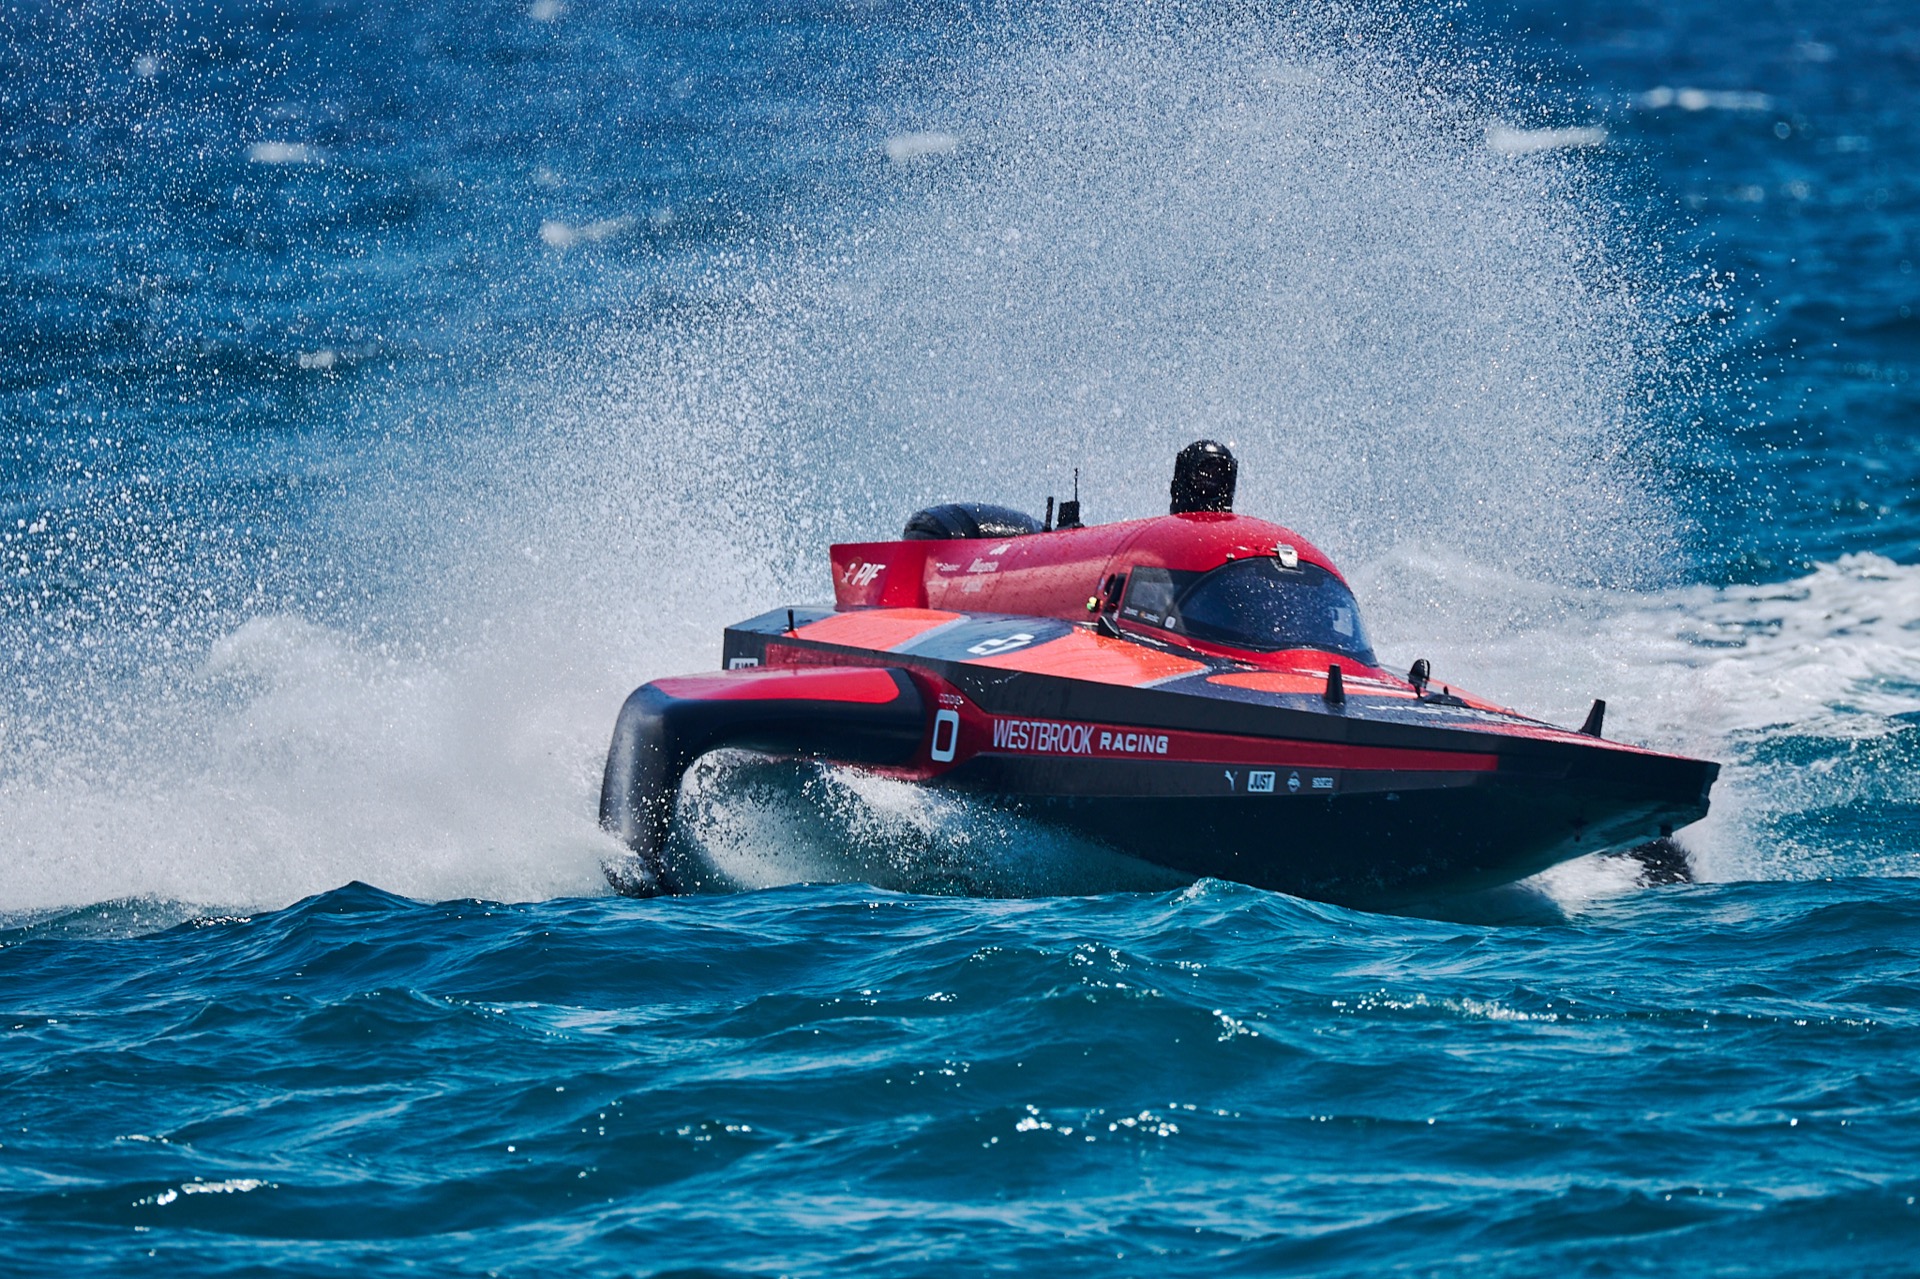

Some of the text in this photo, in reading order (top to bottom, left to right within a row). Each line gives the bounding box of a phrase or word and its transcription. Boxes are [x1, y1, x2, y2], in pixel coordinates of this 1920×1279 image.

[851, 562, 886, 586] PIF
[993, 719, 1168, 754] WESTBROOK RACING
[1250, 773, 1273, 790] JUST
